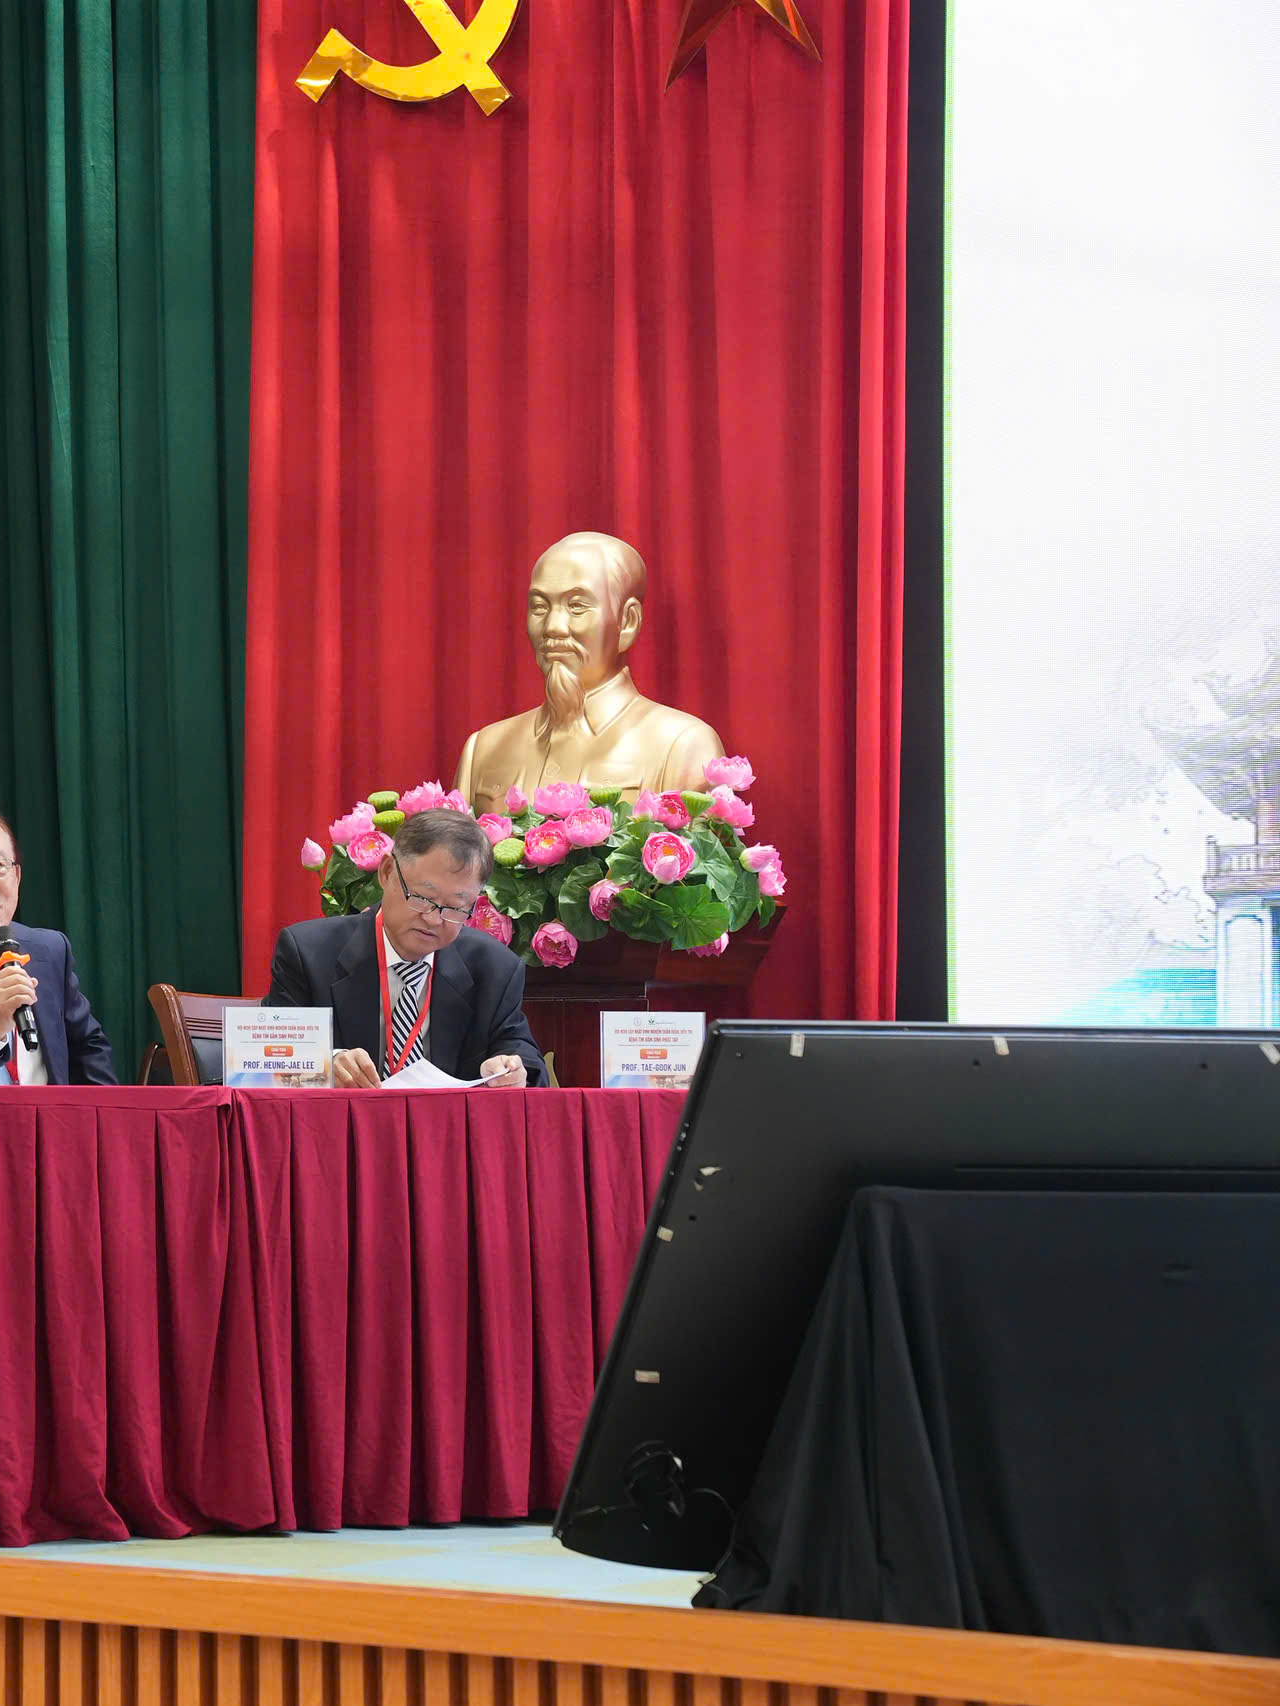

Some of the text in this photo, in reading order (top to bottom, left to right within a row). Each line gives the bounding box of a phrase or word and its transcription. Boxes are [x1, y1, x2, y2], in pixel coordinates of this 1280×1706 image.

[243, 1061, 314, 1070] PROF. HEUNG-JAE LEE
[621, 1063, 686, 1072] PROF. TAE-GOOK JUN
